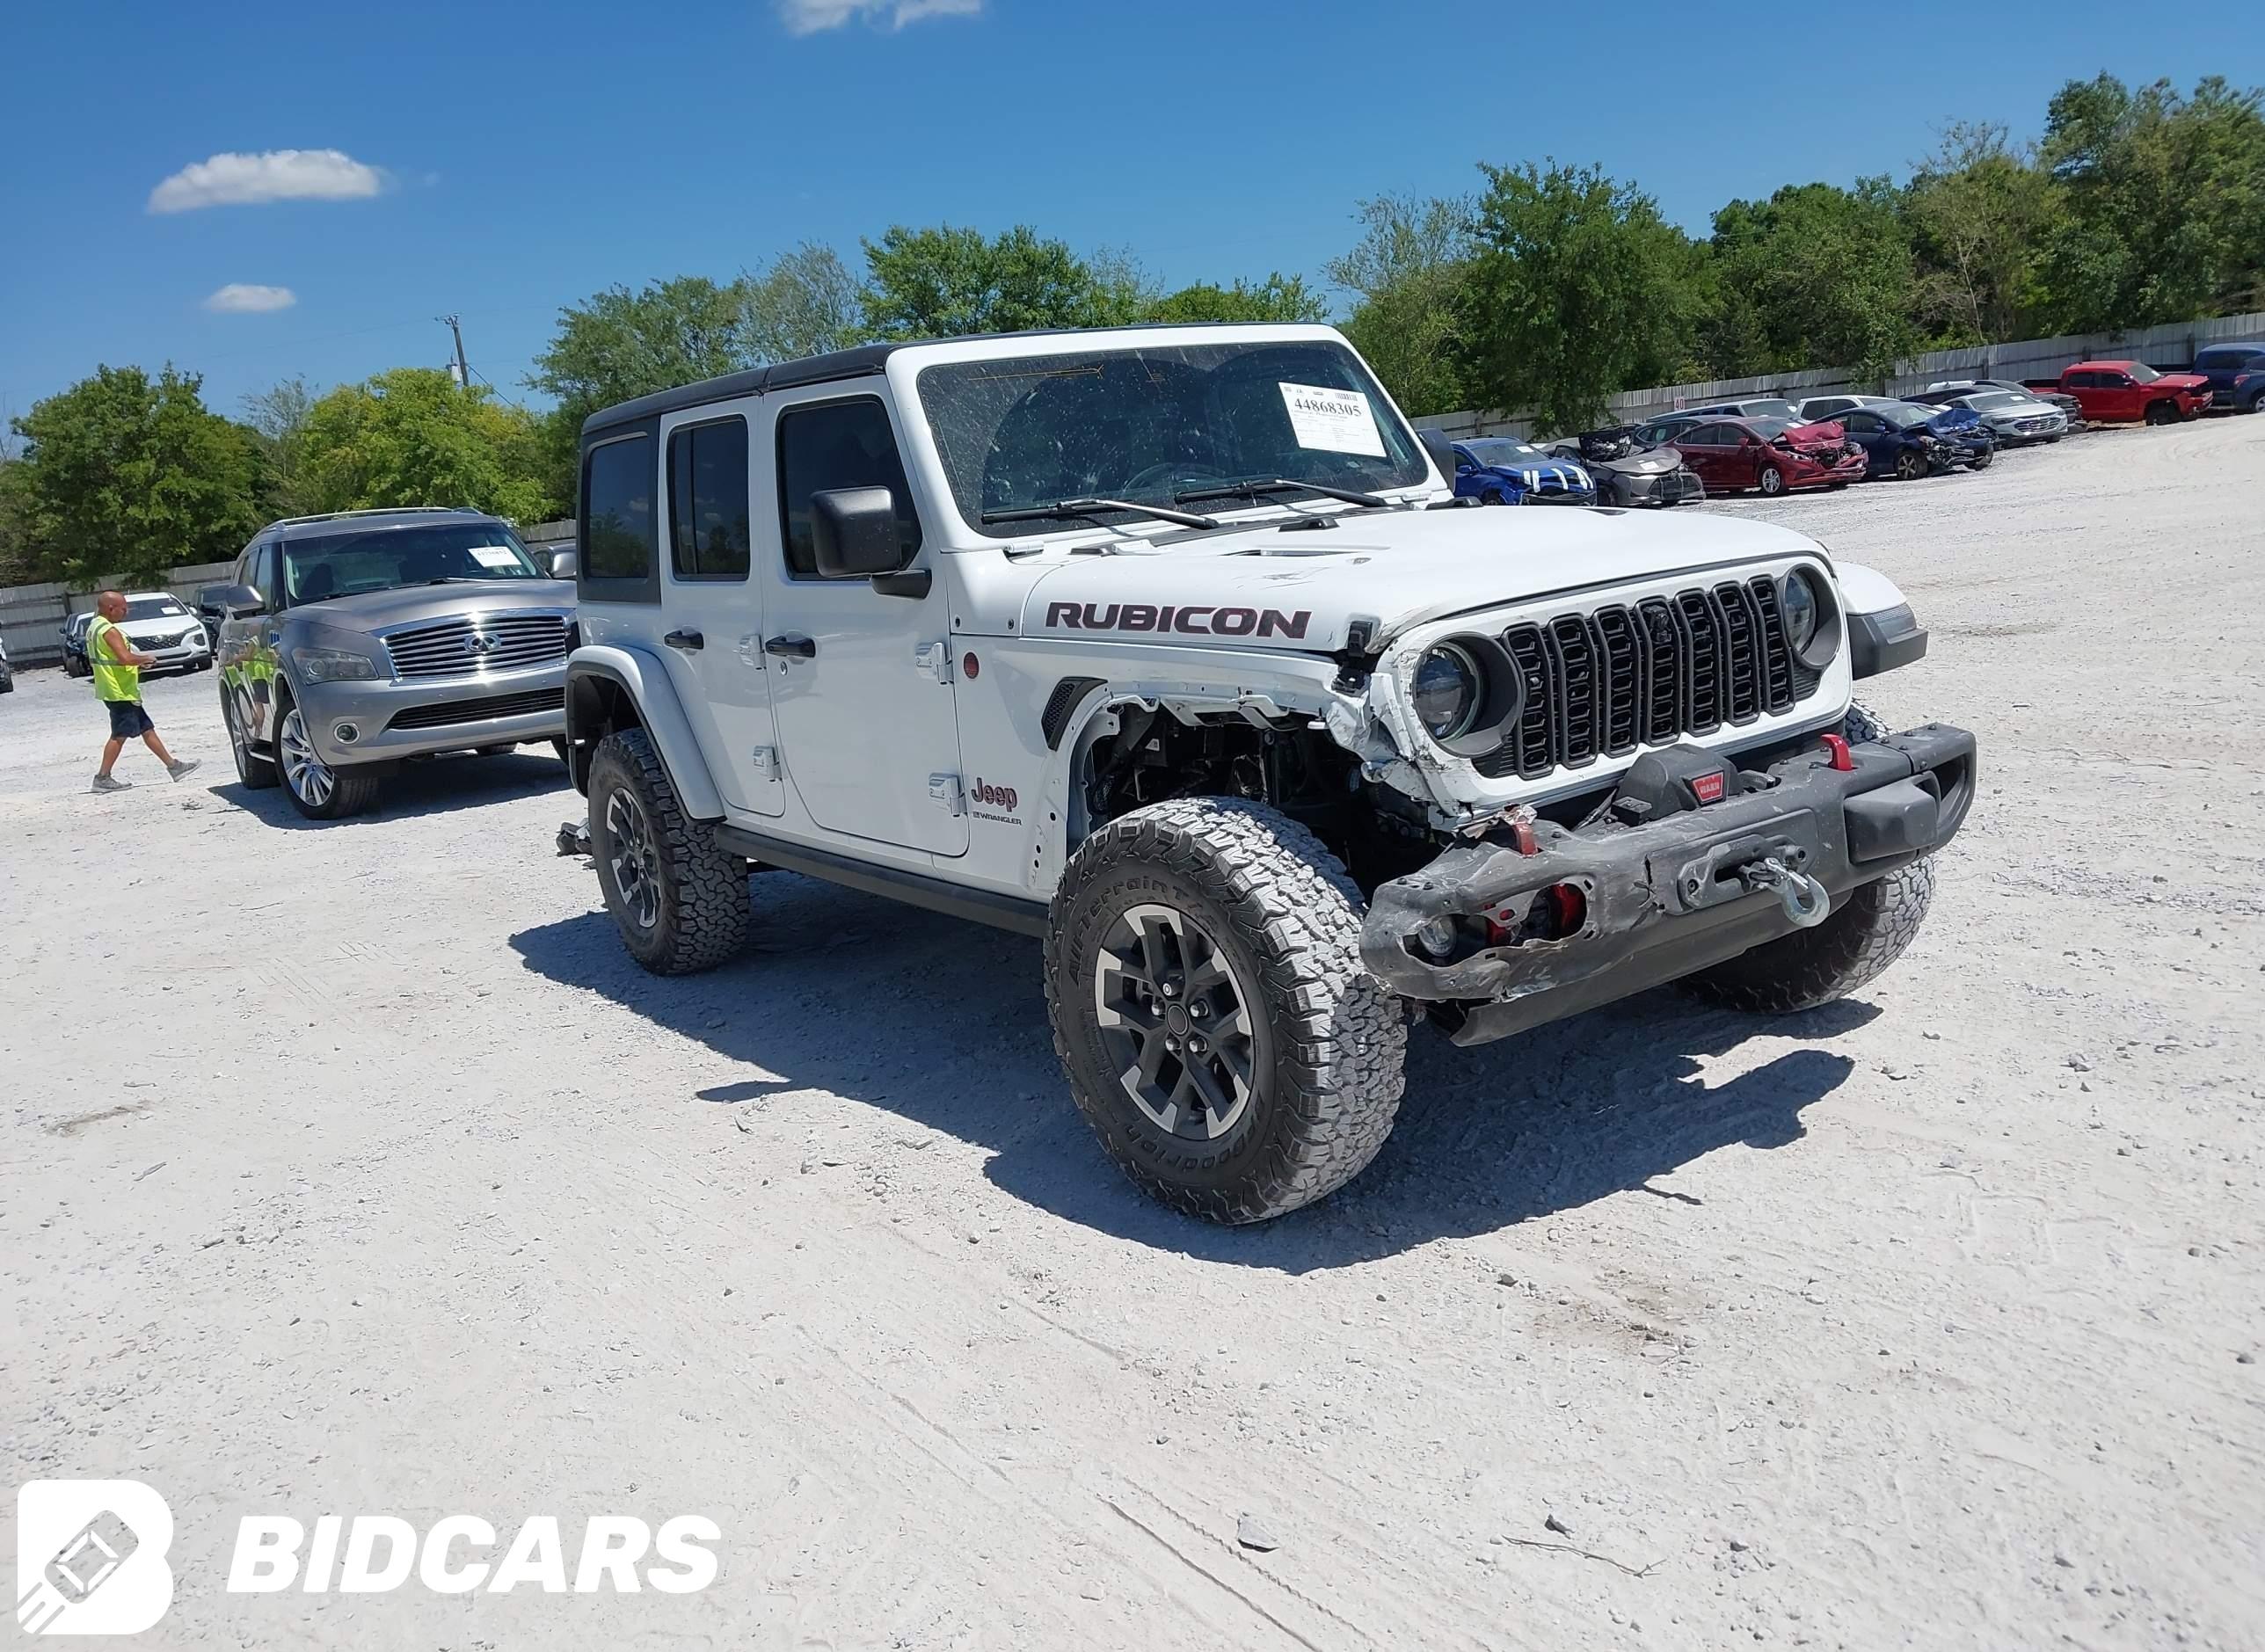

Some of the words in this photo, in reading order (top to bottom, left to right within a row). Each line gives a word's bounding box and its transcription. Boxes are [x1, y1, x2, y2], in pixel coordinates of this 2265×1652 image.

[1294, 397, 1362, 417] 44868305
[1045, 601, 1313, 639] RUBICON
[971, 777, 1017, 812] Jeep
[980, 811, 1023, 826] WRANGLER
